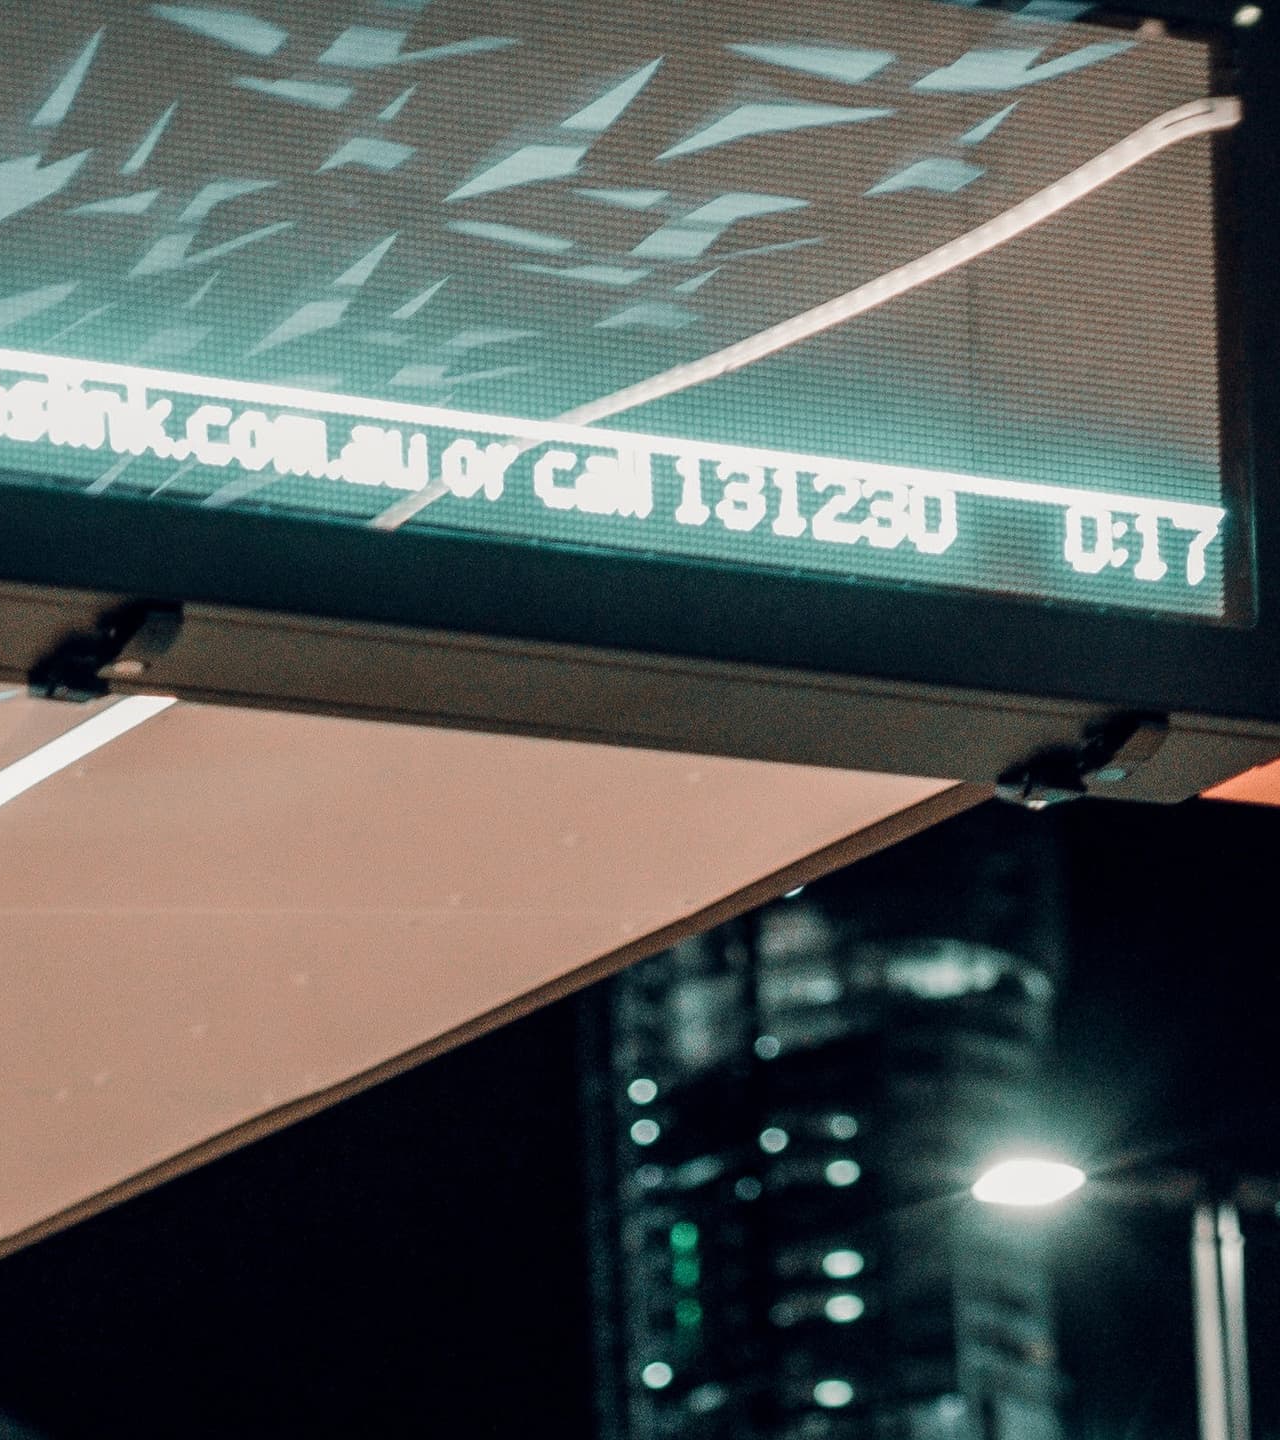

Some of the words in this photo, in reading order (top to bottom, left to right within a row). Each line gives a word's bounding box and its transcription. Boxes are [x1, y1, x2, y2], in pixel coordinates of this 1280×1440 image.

[442, 430, 518, 500] or
[534, 440, 653, 520] call
[675, 452, 958, 555] 131230
